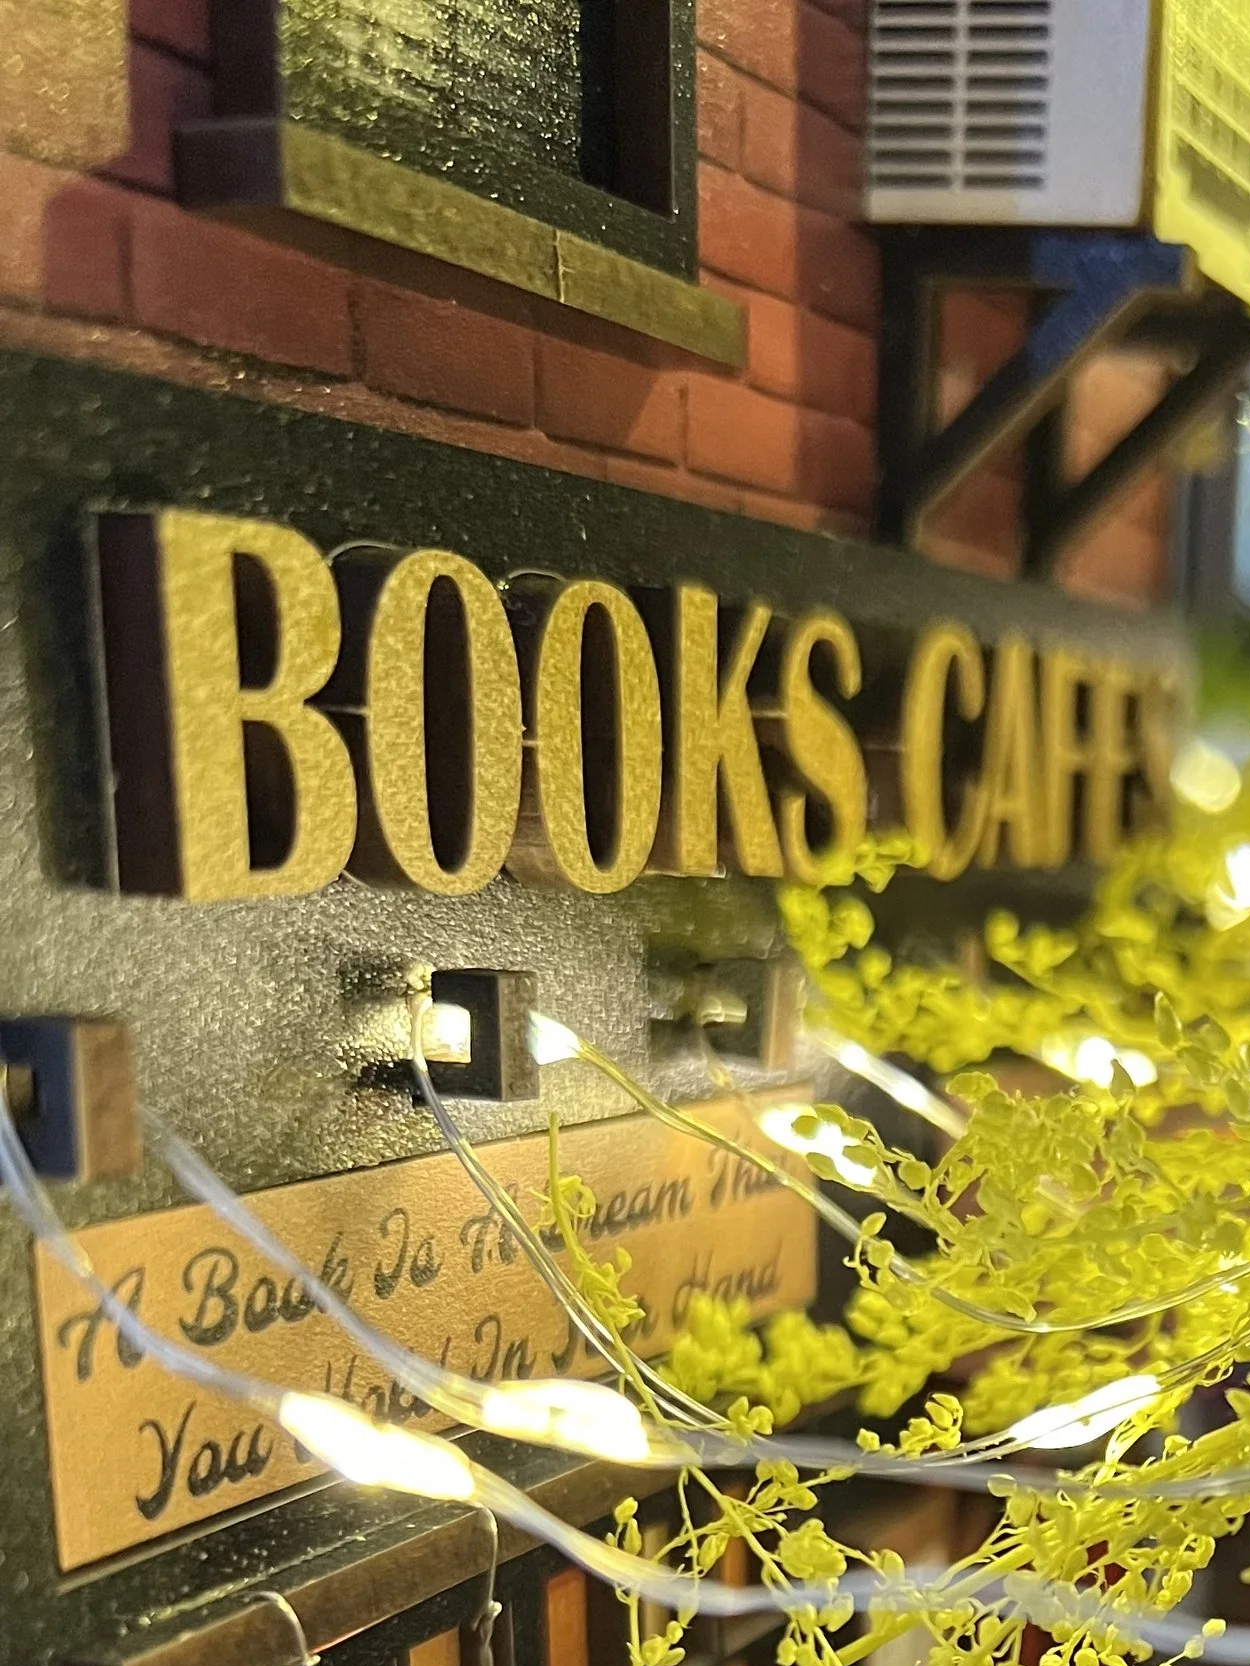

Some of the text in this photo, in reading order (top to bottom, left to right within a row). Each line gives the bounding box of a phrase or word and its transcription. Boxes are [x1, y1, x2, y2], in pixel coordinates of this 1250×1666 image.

[157, 507, 868, 903] BOOKS
[57, 1265, 147, 1385] A
[180, 1231, 356, 1346] Book
[135, 1401, 276, 1521] You
